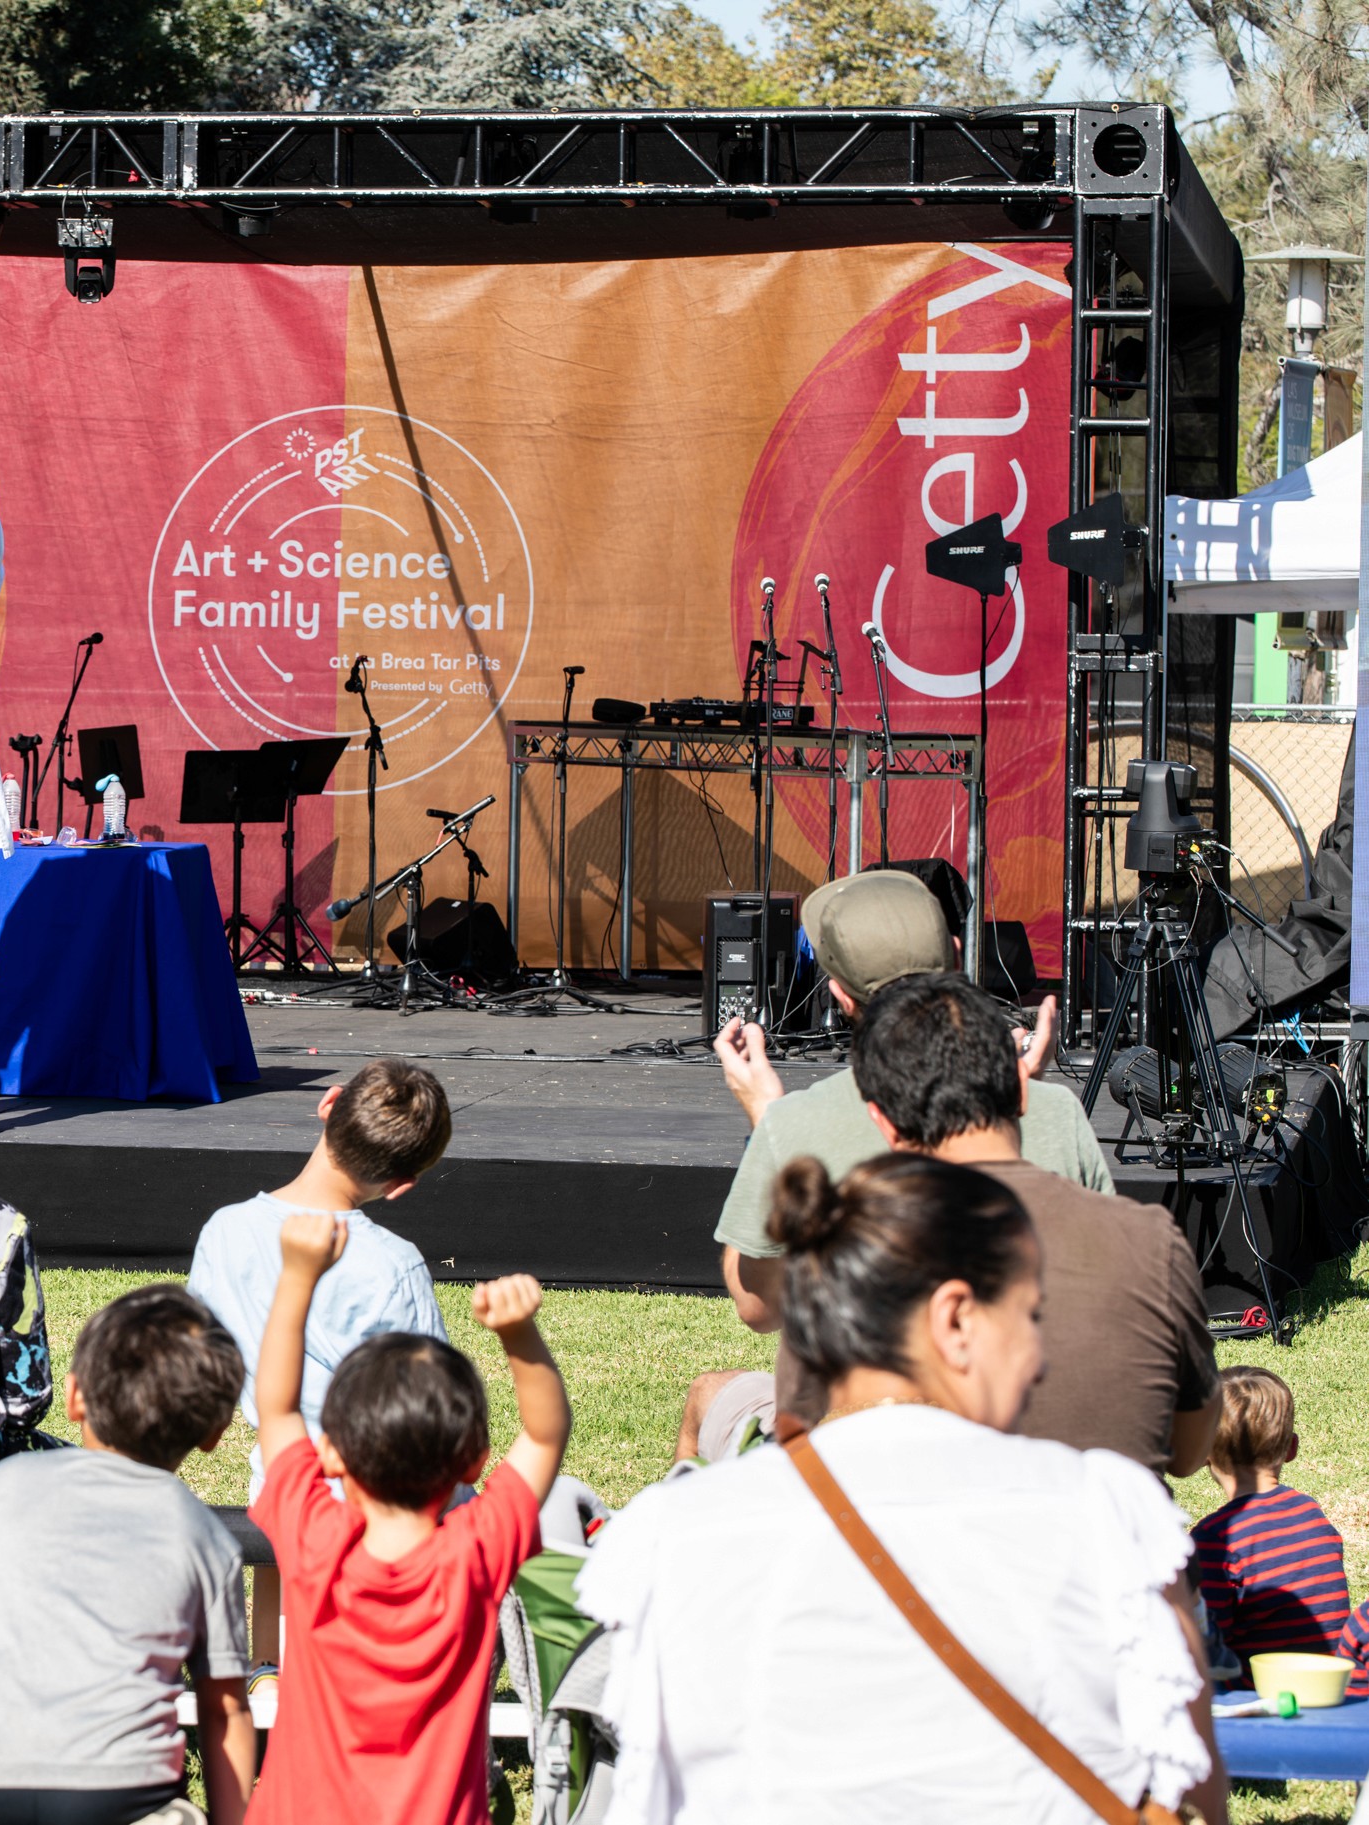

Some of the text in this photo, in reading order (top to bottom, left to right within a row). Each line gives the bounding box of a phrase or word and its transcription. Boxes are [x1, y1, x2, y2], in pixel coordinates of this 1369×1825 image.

[315, 427, 364, 477] PST
[871, 242, 1073, 698] Getty
[318, 454, 380, 497] ART
[949, 546, 986, 555] SHURE
[1070, 529, 1107, 540] SHURE
[172, 540, 451, 579] Art + Science
[173, 590, 505, 640] Family Festival
[329, 653, 350, 669] at
[381, 652, 425, 670] Brea
[430, 653, 461, 670] Tar
[466, 653, 501, 671] Pits
[370, 679, 492, 699] Presented by Getty
